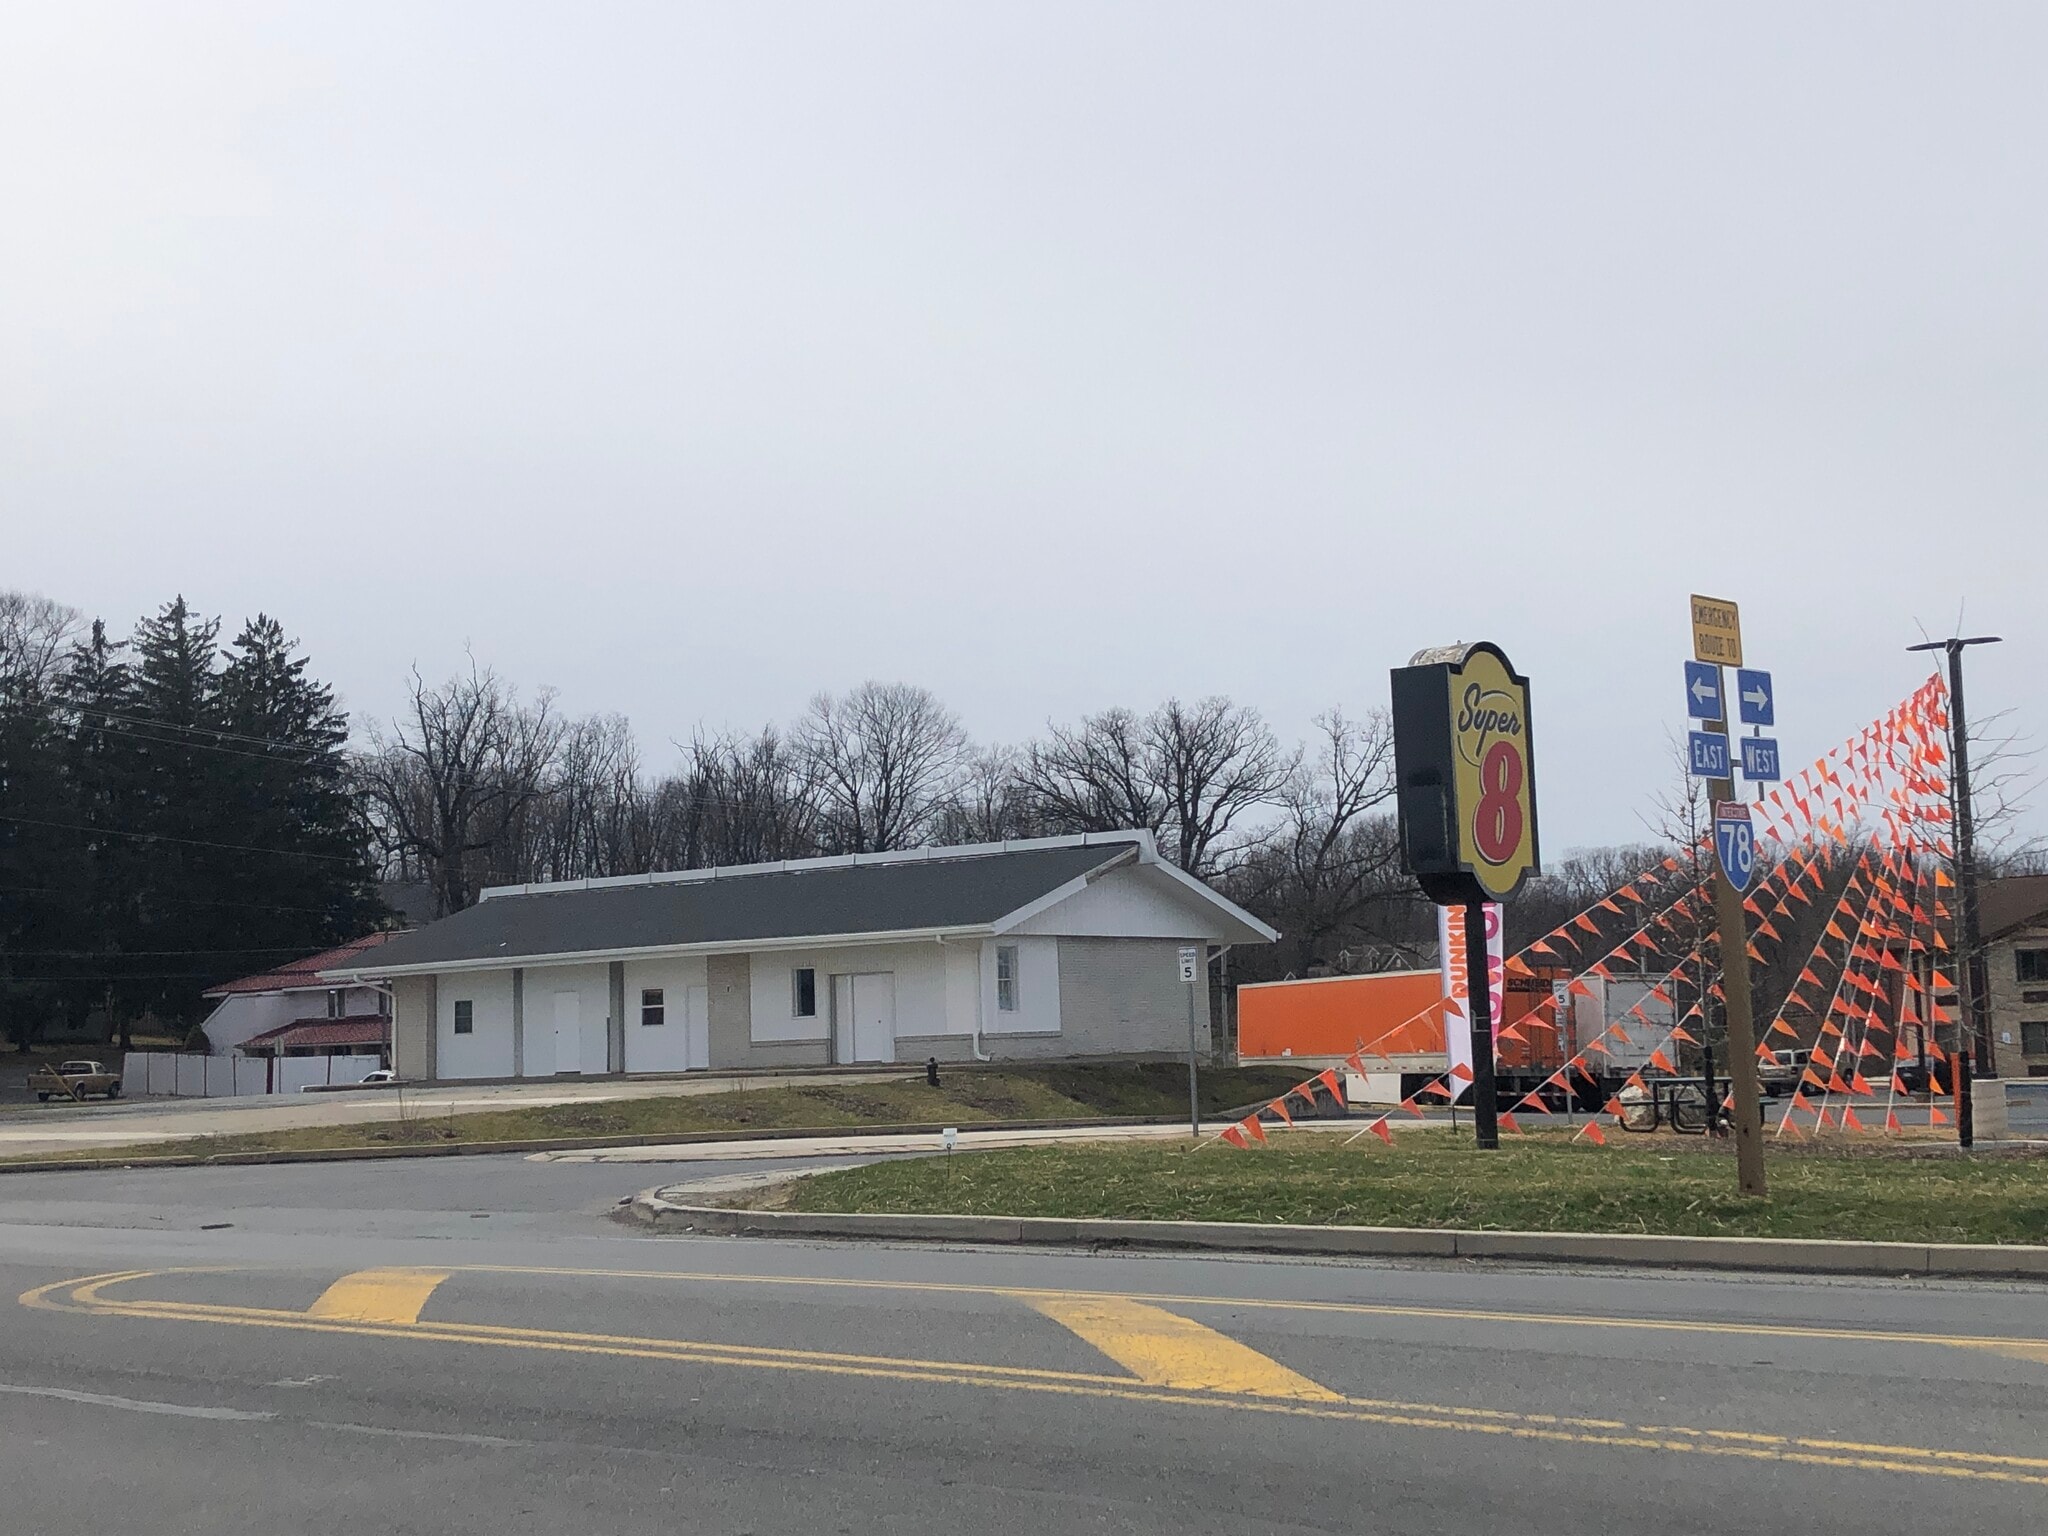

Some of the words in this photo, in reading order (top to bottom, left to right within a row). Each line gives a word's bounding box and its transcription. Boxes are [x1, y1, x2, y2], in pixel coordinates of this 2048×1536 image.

[1694, 604, 1736, 630] EMERGENCY
[1699, 633, 1725, 656] ROUTE
[1727, 638, 1737, 658] TO
[1458, 682, 1521, 758] Super
[1472, 740, 1523, 866] 8
[1720, 823, 1751, 873] 78
[1184, 966, 1192, 978] 5
[1558, 994, 1565, 1004] 5
